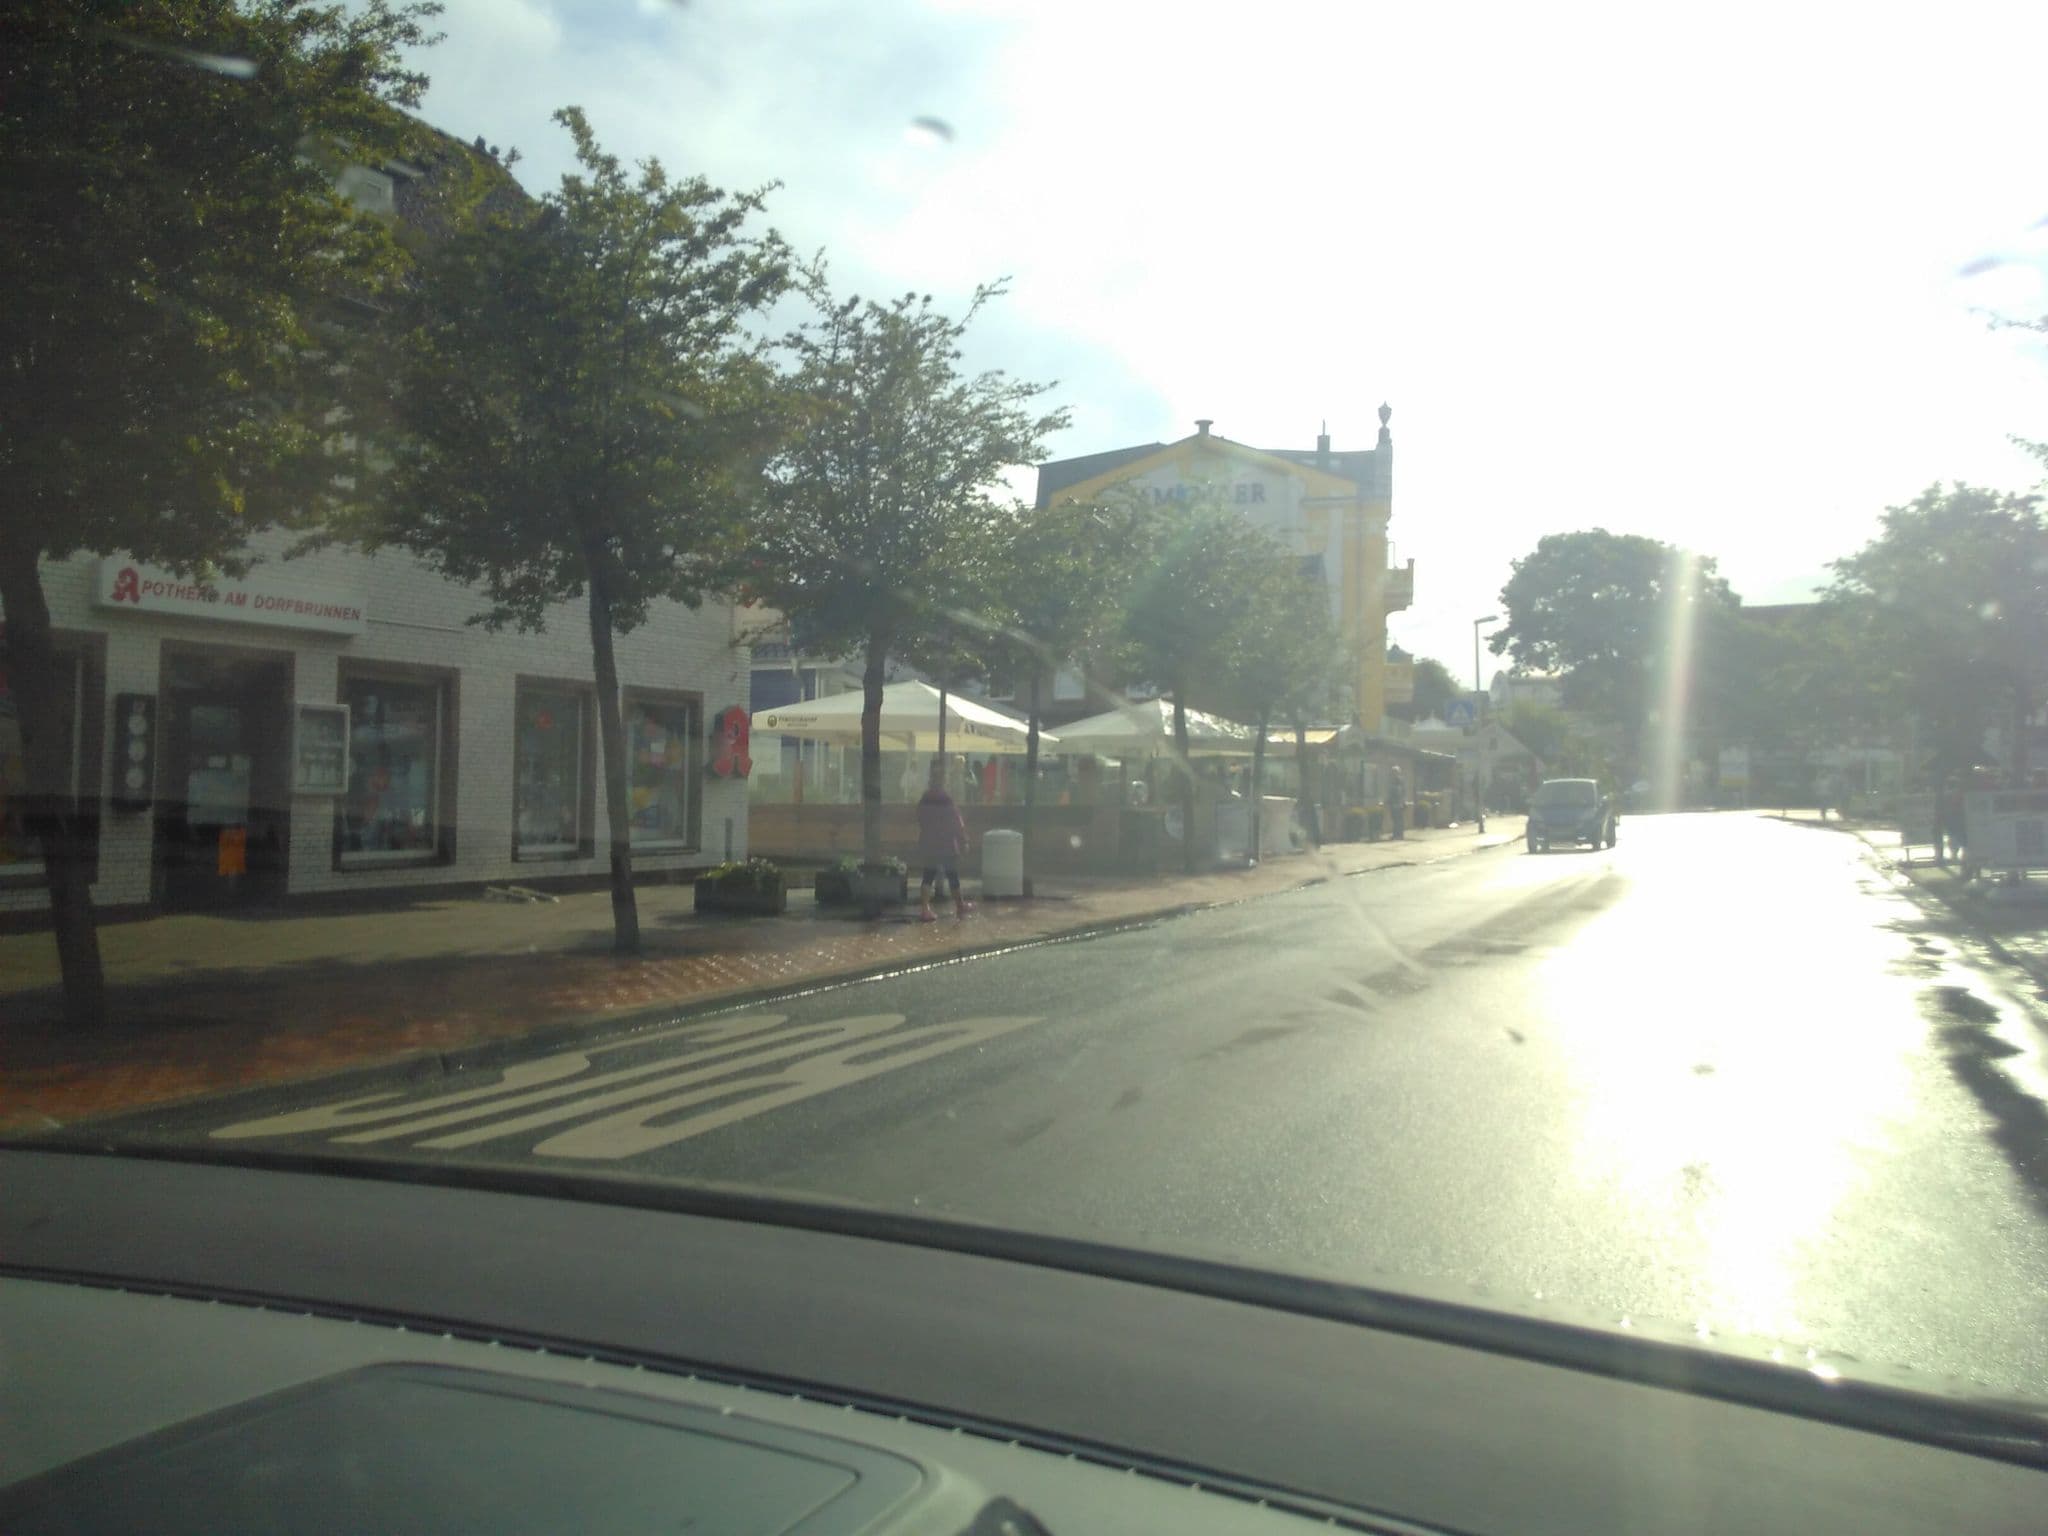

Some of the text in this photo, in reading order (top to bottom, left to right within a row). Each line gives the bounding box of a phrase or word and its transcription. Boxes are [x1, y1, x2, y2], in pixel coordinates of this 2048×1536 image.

[111, 567, 362, 621] APOTHEK AM DORFBRUNNEN
